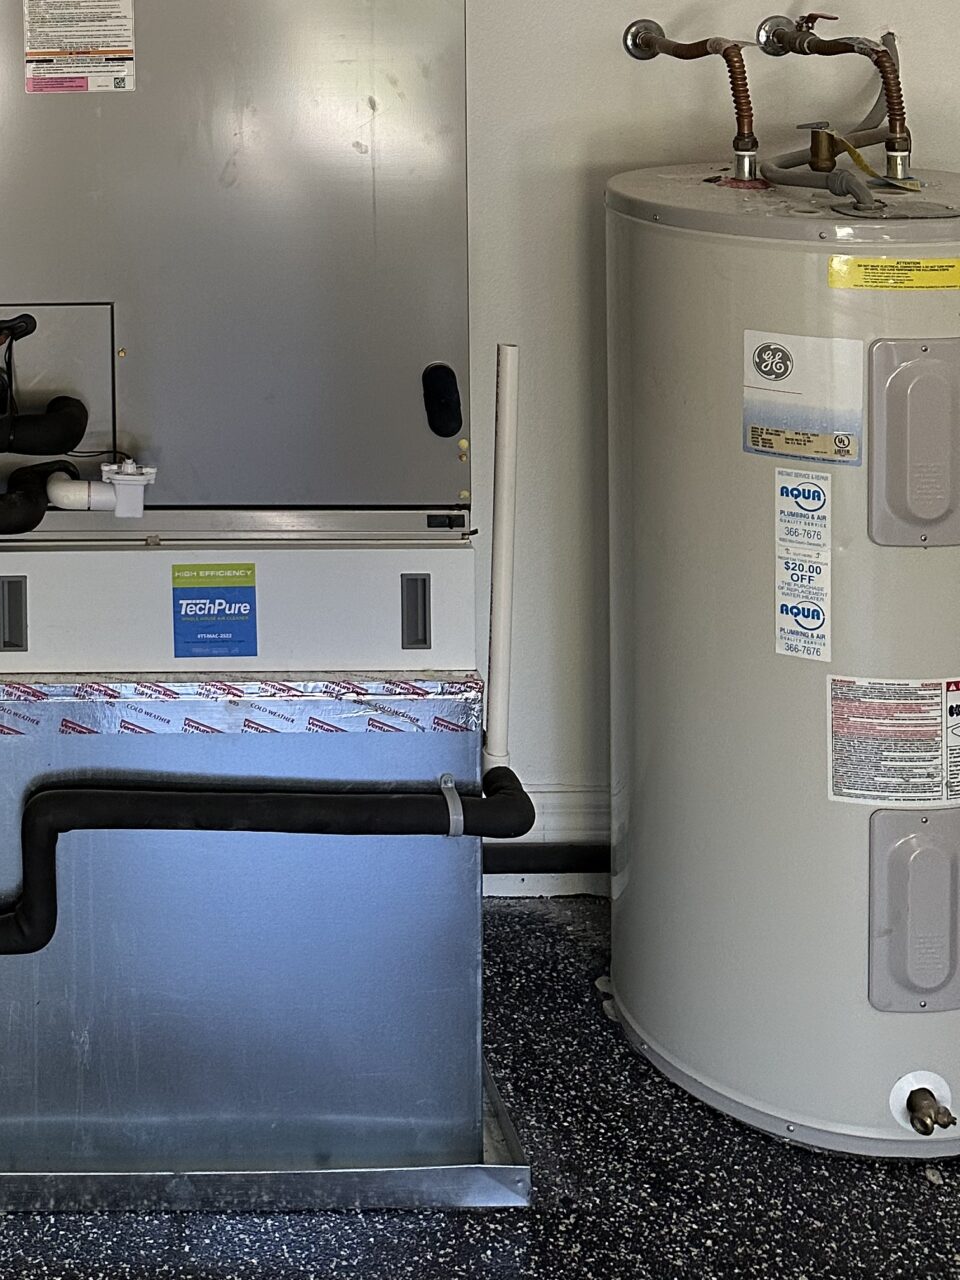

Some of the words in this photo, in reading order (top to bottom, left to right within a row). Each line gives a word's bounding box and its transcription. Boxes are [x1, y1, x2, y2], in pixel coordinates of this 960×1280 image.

[780, 486, 822, 501] AQUA
[780, 510, 810, 520] PLUMBING
[784, 526, 822, 540] 366-7676
[175, 570, 196, 578] HIGH
[784, 561, 822, 575] $20.00
[790, 573, 815, 584] OFF
[794, 582, 825, 592] PURCHASE
[179, 600, 251, 616] TechPure
[780, 604, 820, 620] AQUA
[780, 627, 809, 638] PLUMBING
[784, 642, 821, 656] 366-7676
[12, 711, 40, 726] WEATHER
[126, 703, 144, 714] COLD
[144, 710, 172, 726] WEATHER
[250, 702, 268, 714] COLD
[268, 709, 296, 724] WEATHER
